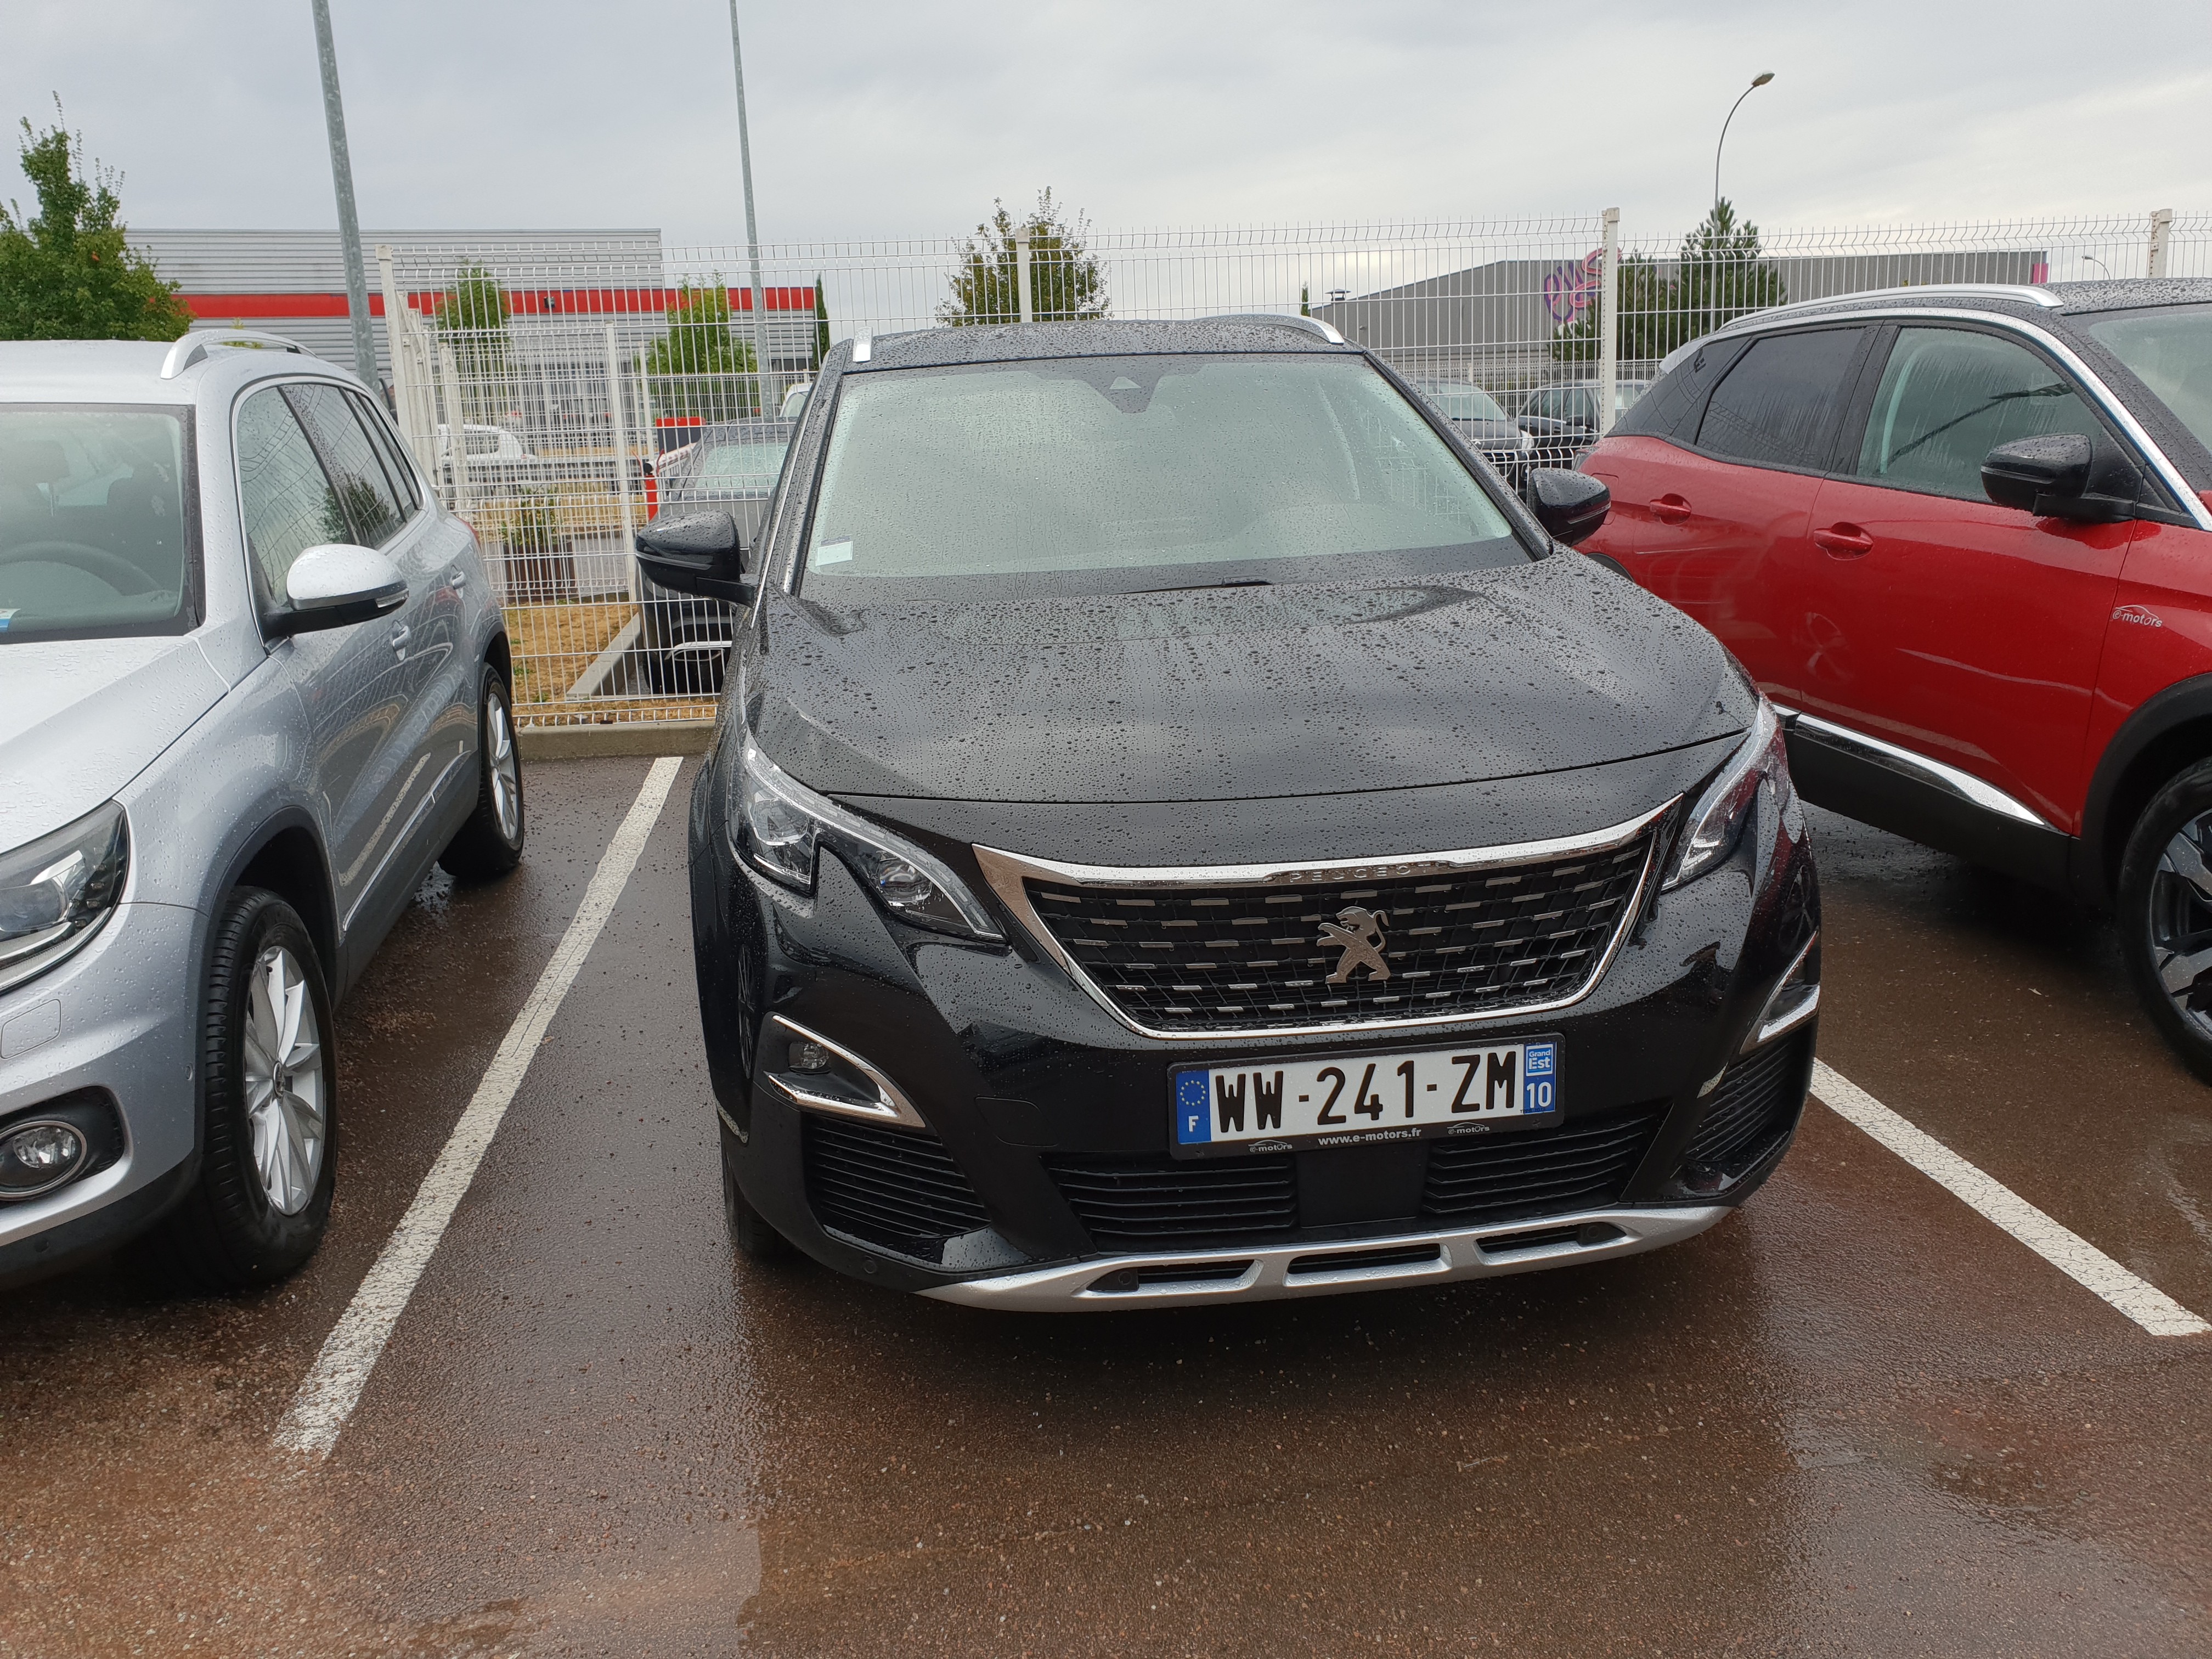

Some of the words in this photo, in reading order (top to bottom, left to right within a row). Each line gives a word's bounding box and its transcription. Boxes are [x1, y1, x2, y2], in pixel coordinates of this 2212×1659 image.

[1528, 1057, 1550, 1070] Est
[1215, 1051, 1516, 1133] WW-241-ZM
[1526, 1081, 1552, 1109] 10
[1188, 1115, 1199, 1132] F
[1318, 1127, 1422, 1146] www.e-motors.fr
